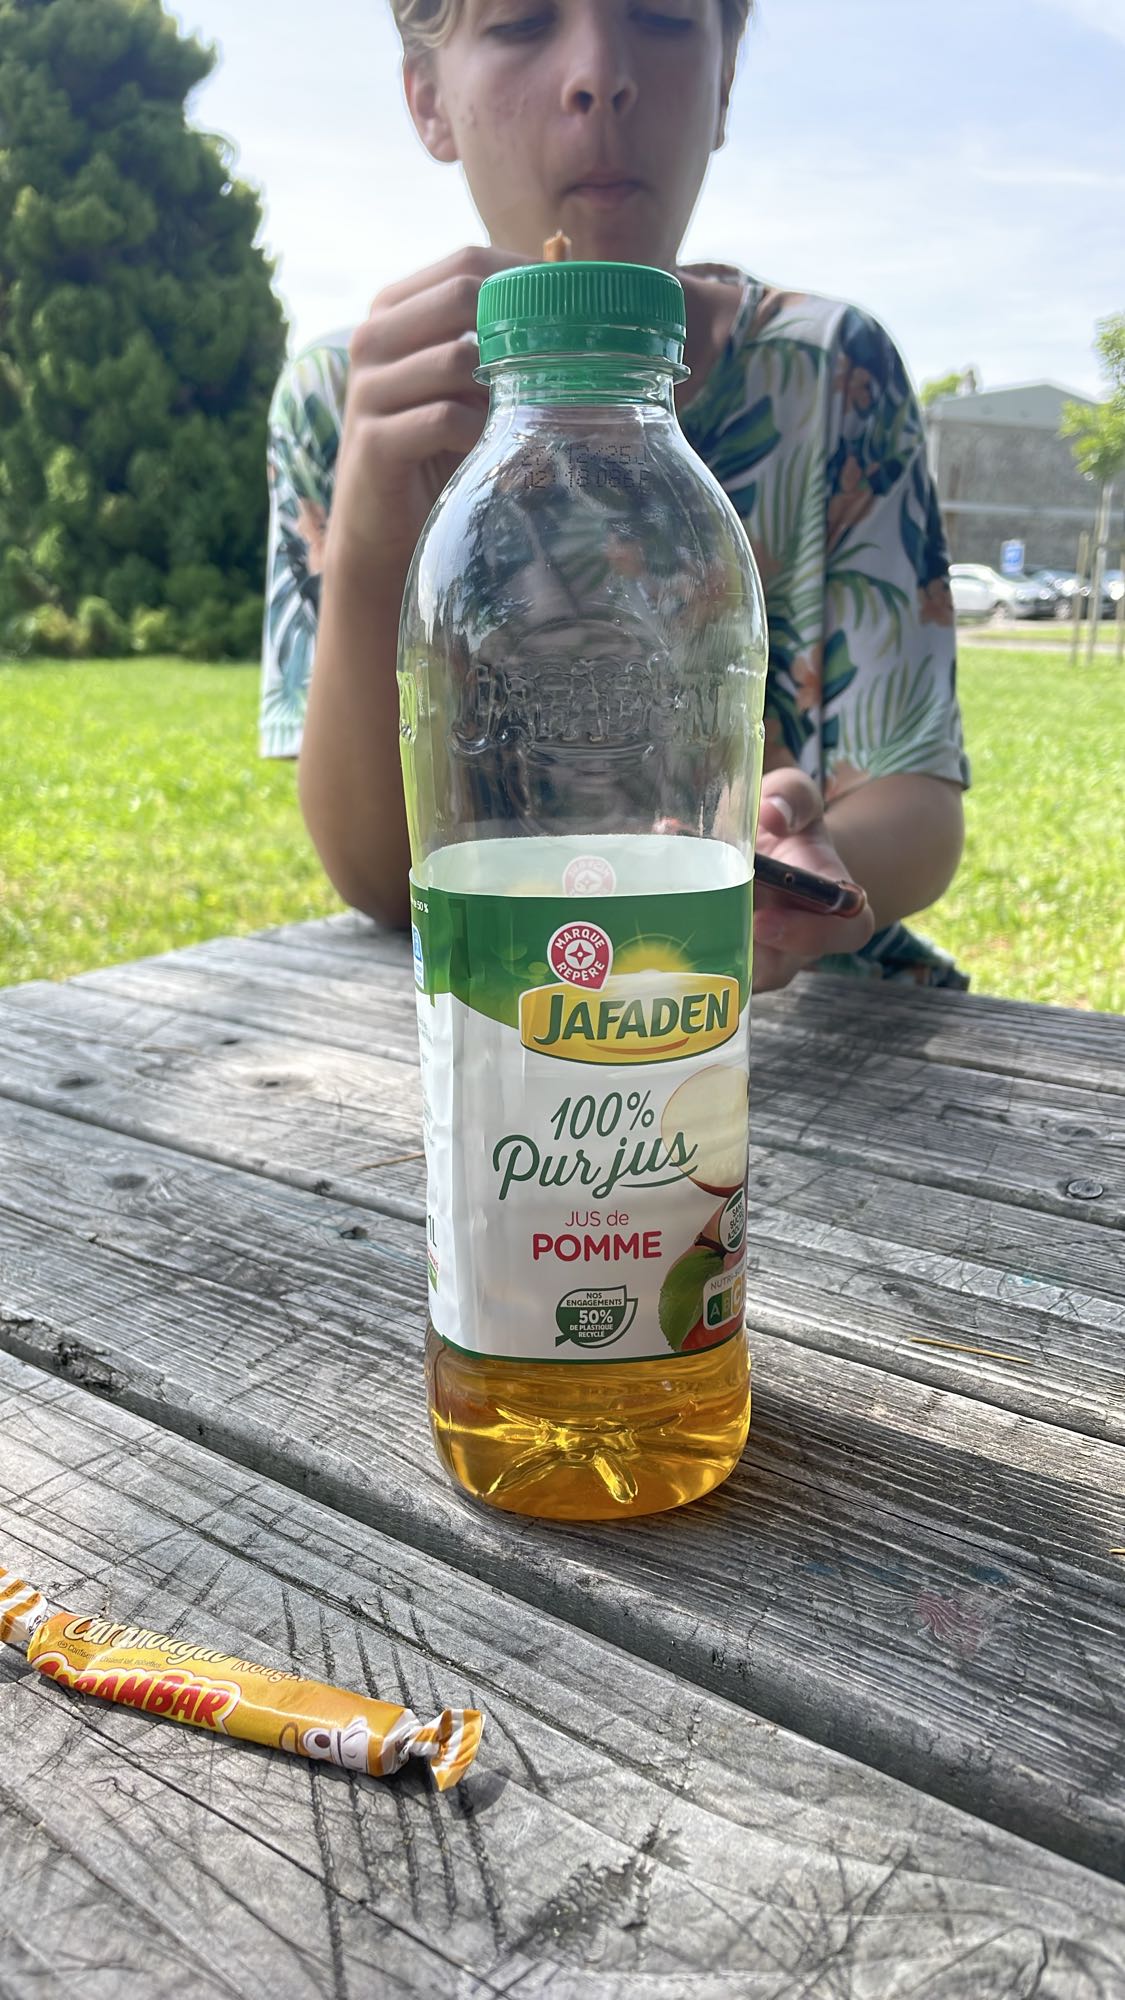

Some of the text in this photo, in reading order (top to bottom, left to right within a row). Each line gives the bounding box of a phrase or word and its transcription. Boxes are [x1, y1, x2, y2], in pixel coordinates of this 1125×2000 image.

[554, 928, 606, 950] MARQUE
[532, 989, 730, 1045] JAFADEN
[550, 1089, 655, 1140] 100%
[492, 1131, 699, 1201] Pur jus
[565, 1210, 629, 1228] JUS de
[532, 1231, 663, 1262] POMME
[578, 1309, 613, 1324] 50%
[231, 1659, 307, 1684] Noug
